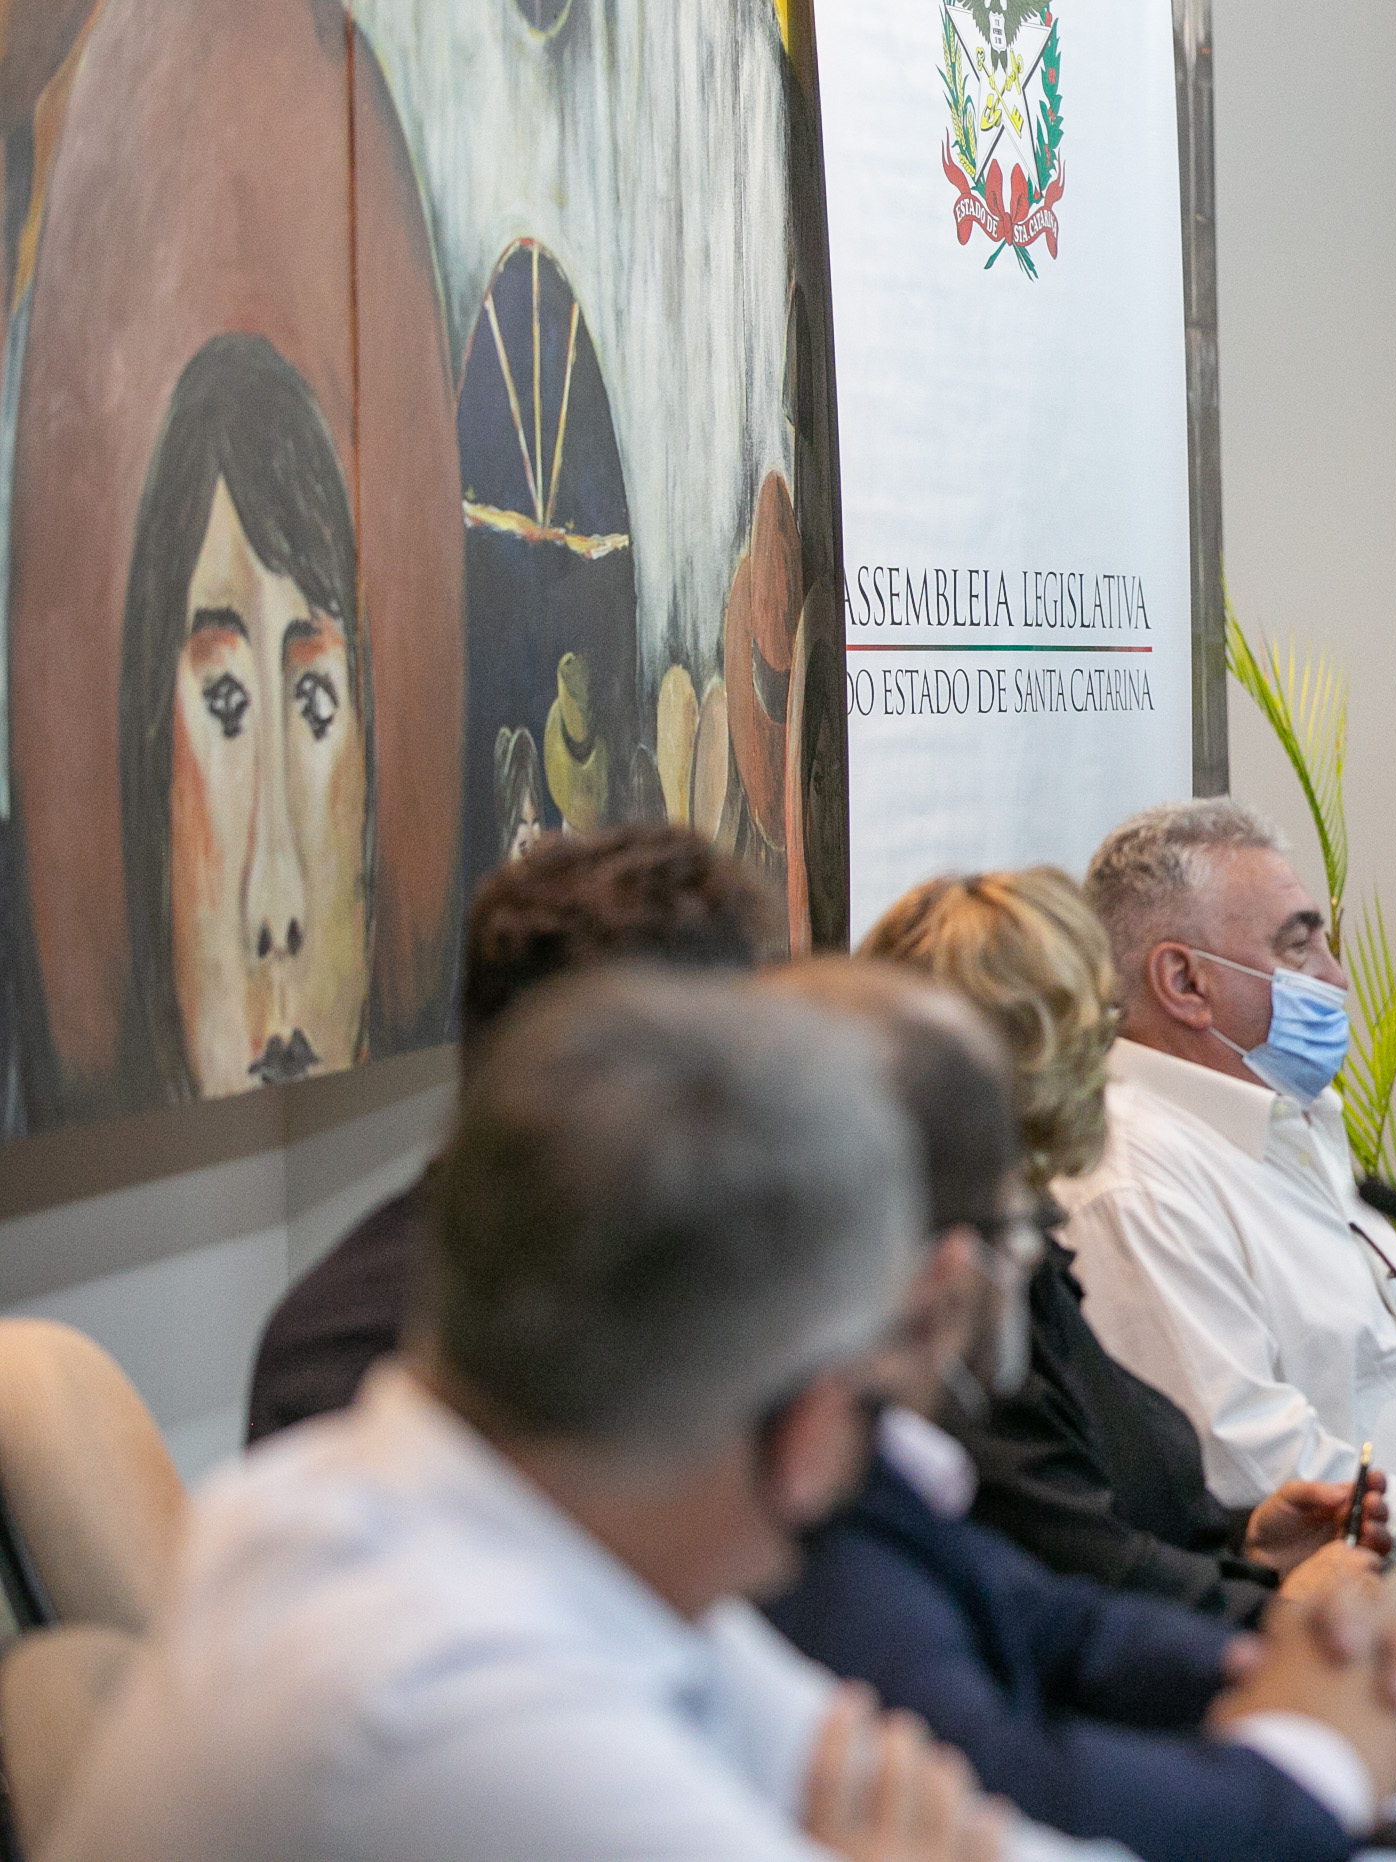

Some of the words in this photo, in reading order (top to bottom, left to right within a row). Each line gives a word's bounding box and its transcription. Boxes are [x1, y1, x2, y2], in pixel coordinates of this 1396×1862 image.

[956, 199, 986, 224] ESTADO
[986, 218, 998, 238] DE
[1029, 210, 1057, 238] CATARINA
[844, 565, 1015, 627] ASSEMBLEIA
[1022, 571, 1152, 630] LEGISLATIVA
[881, 668, 970, 715] ESTADO
[976, 668, 1008, 714] DE
[1014, 667, 1068, 713] SANTA
[1069, 667, 1155, 712] CATARINA
